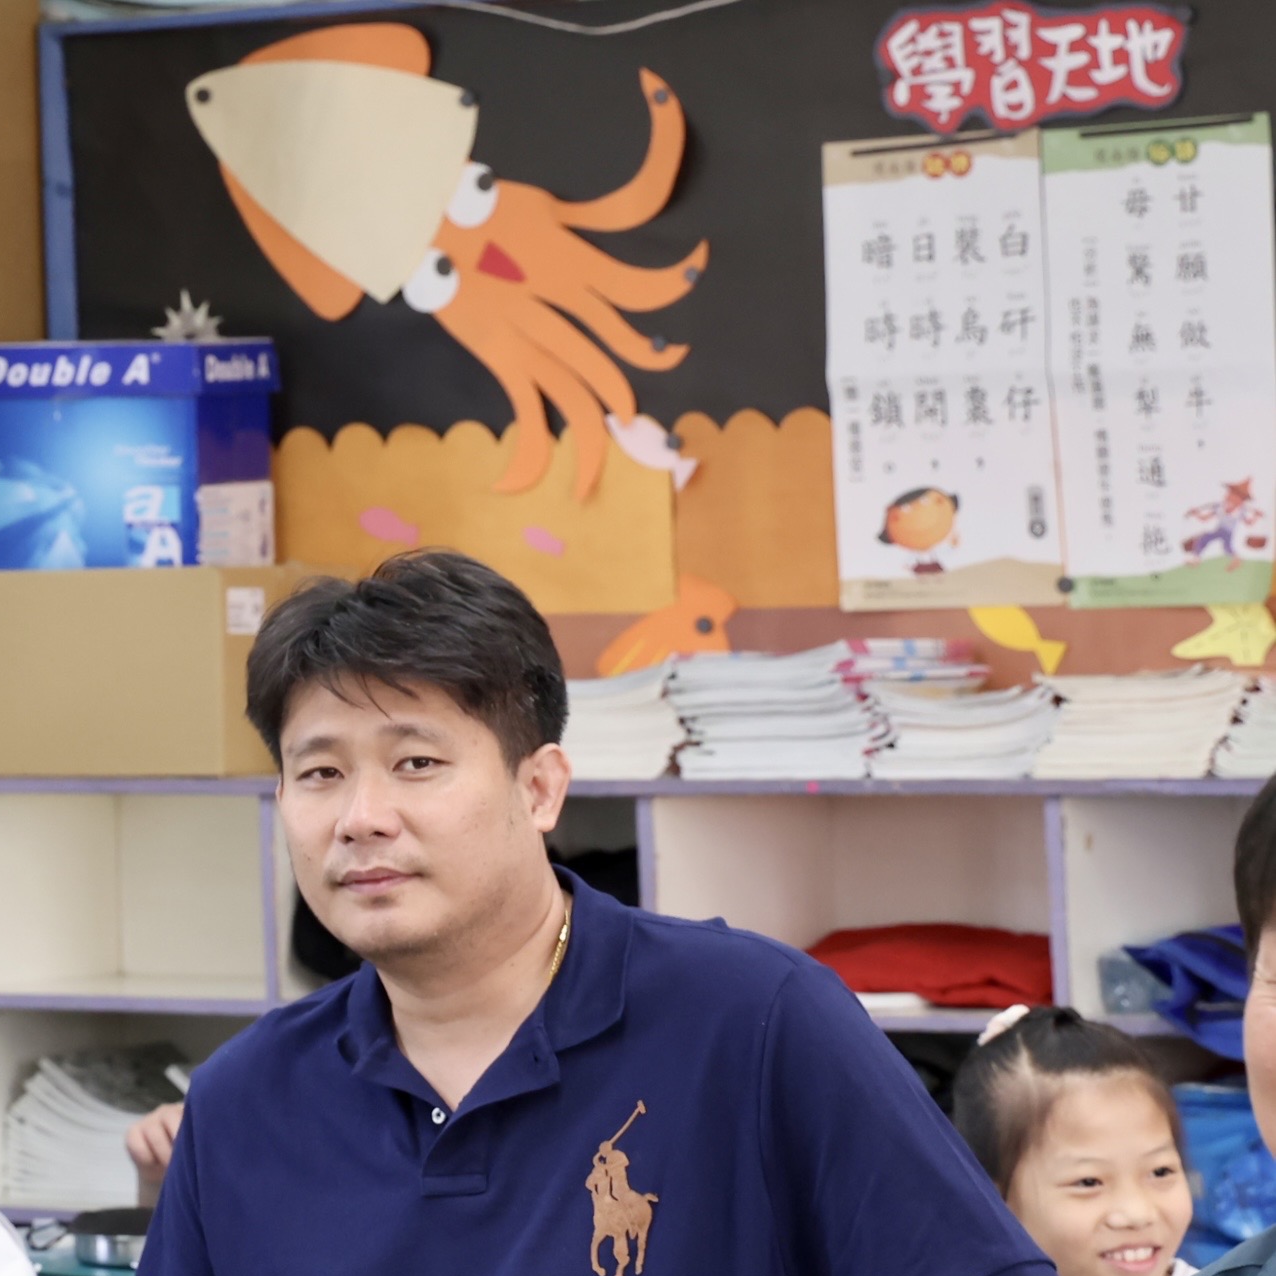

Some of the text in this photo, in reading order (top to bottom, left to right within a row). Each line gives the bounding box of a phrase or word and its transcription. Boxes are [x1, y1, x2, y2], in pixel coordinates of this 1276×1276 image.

[887, 8, 1175, 124] 學習天地
[122, 353, 150, 386] A
[205, 354, 254, 384] Double
